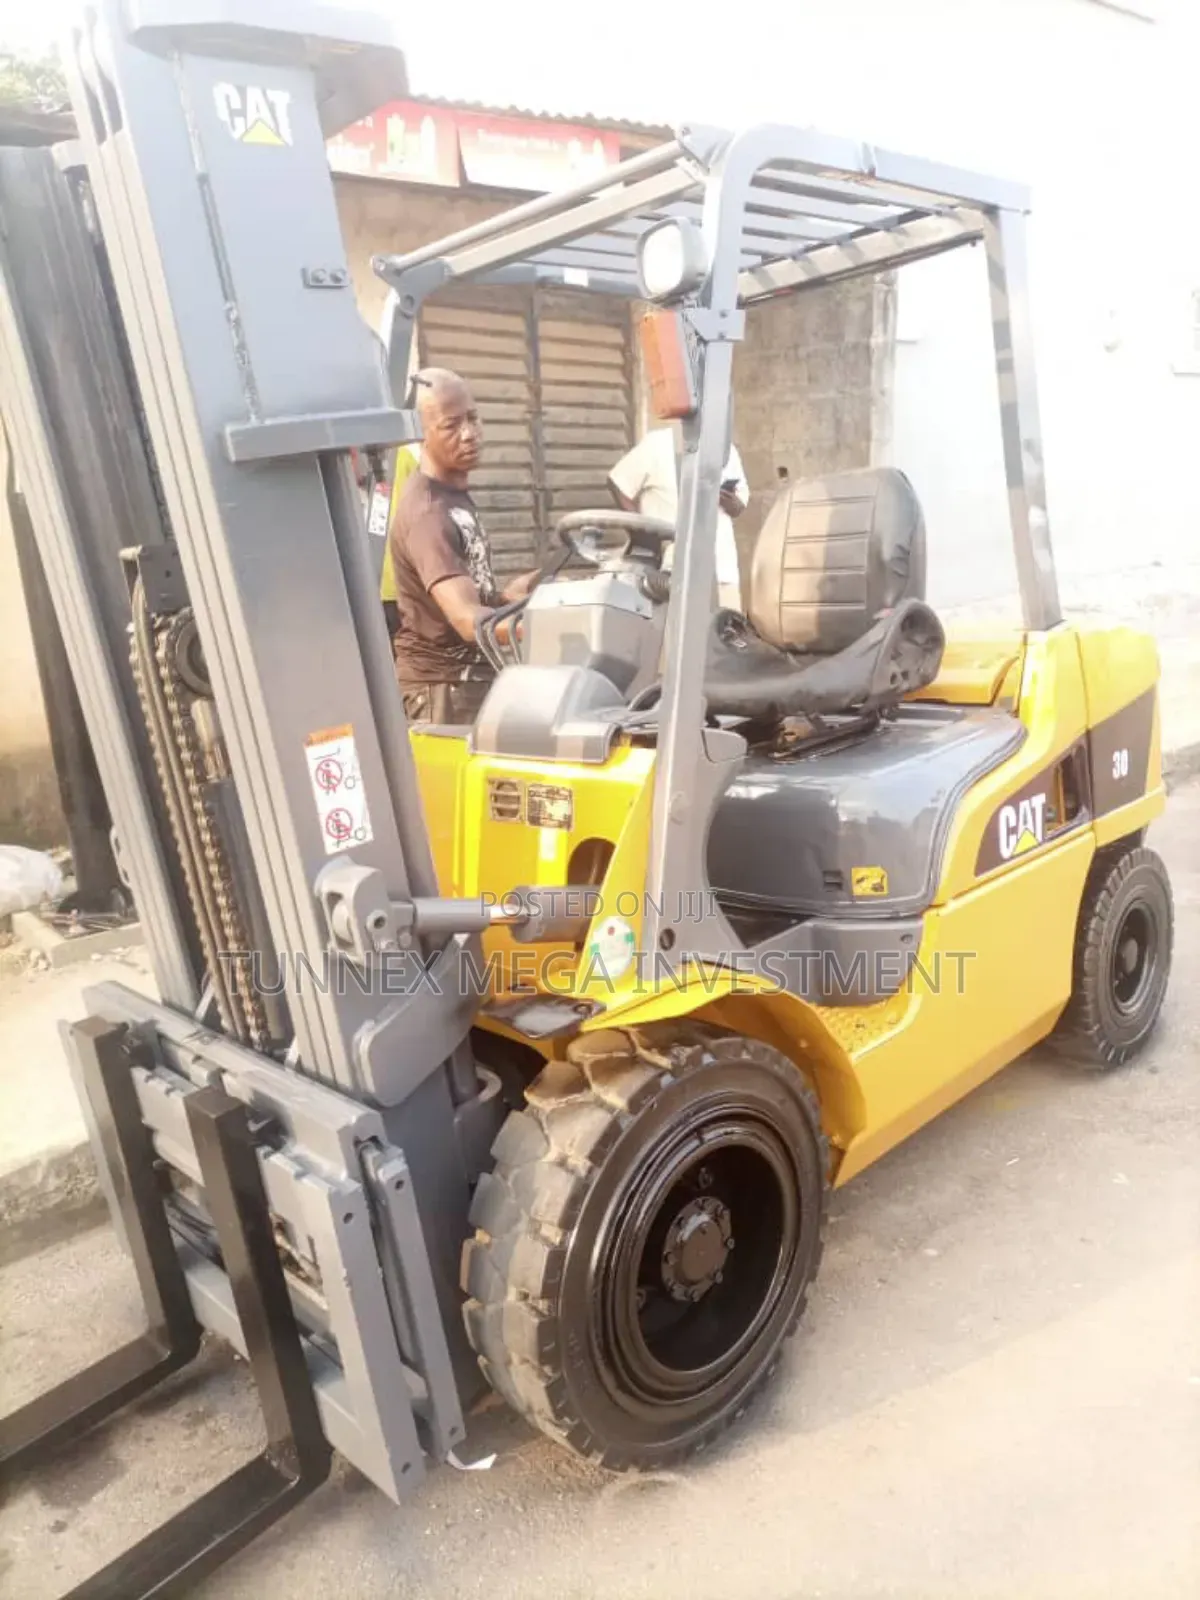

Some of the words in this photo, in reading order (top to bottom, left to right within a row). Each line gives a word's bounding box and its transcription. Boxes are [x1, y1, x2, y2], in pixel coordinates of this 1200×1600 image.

[213, 82, 294, 147] CAT
[1112, 748, 1129, 779] 30
[999, 792, 1046, 858] CAT
